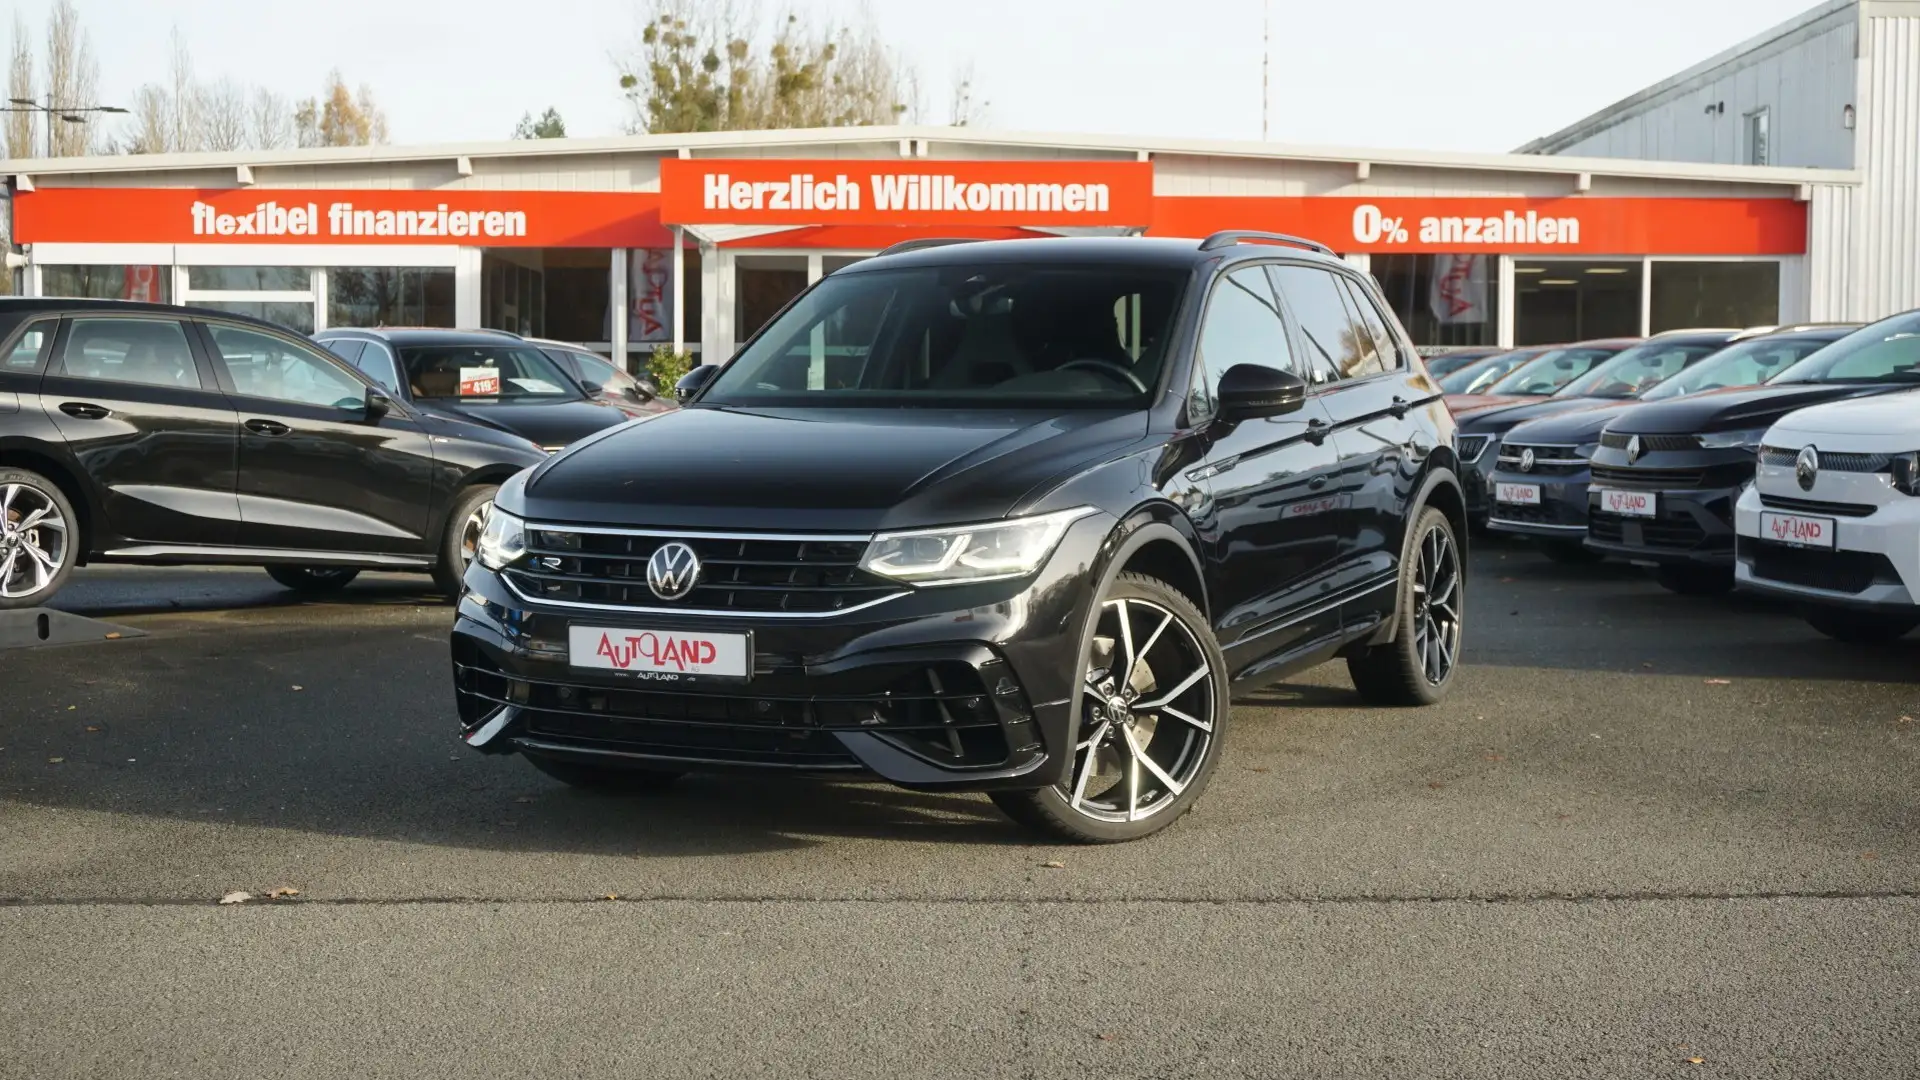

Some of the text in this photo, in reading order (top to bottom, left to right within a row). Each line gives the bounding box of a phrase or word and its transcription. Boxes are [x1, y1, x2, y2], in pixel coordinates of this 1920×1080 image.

[704, 174, 1110, 212] Herzlich Willkommen
[191, 201, 527, 237] flexibel finanzieren
[1353, 204, 1580, 244] 0% anzahlen
[596, 632, 717, 671] AUTOLAND
